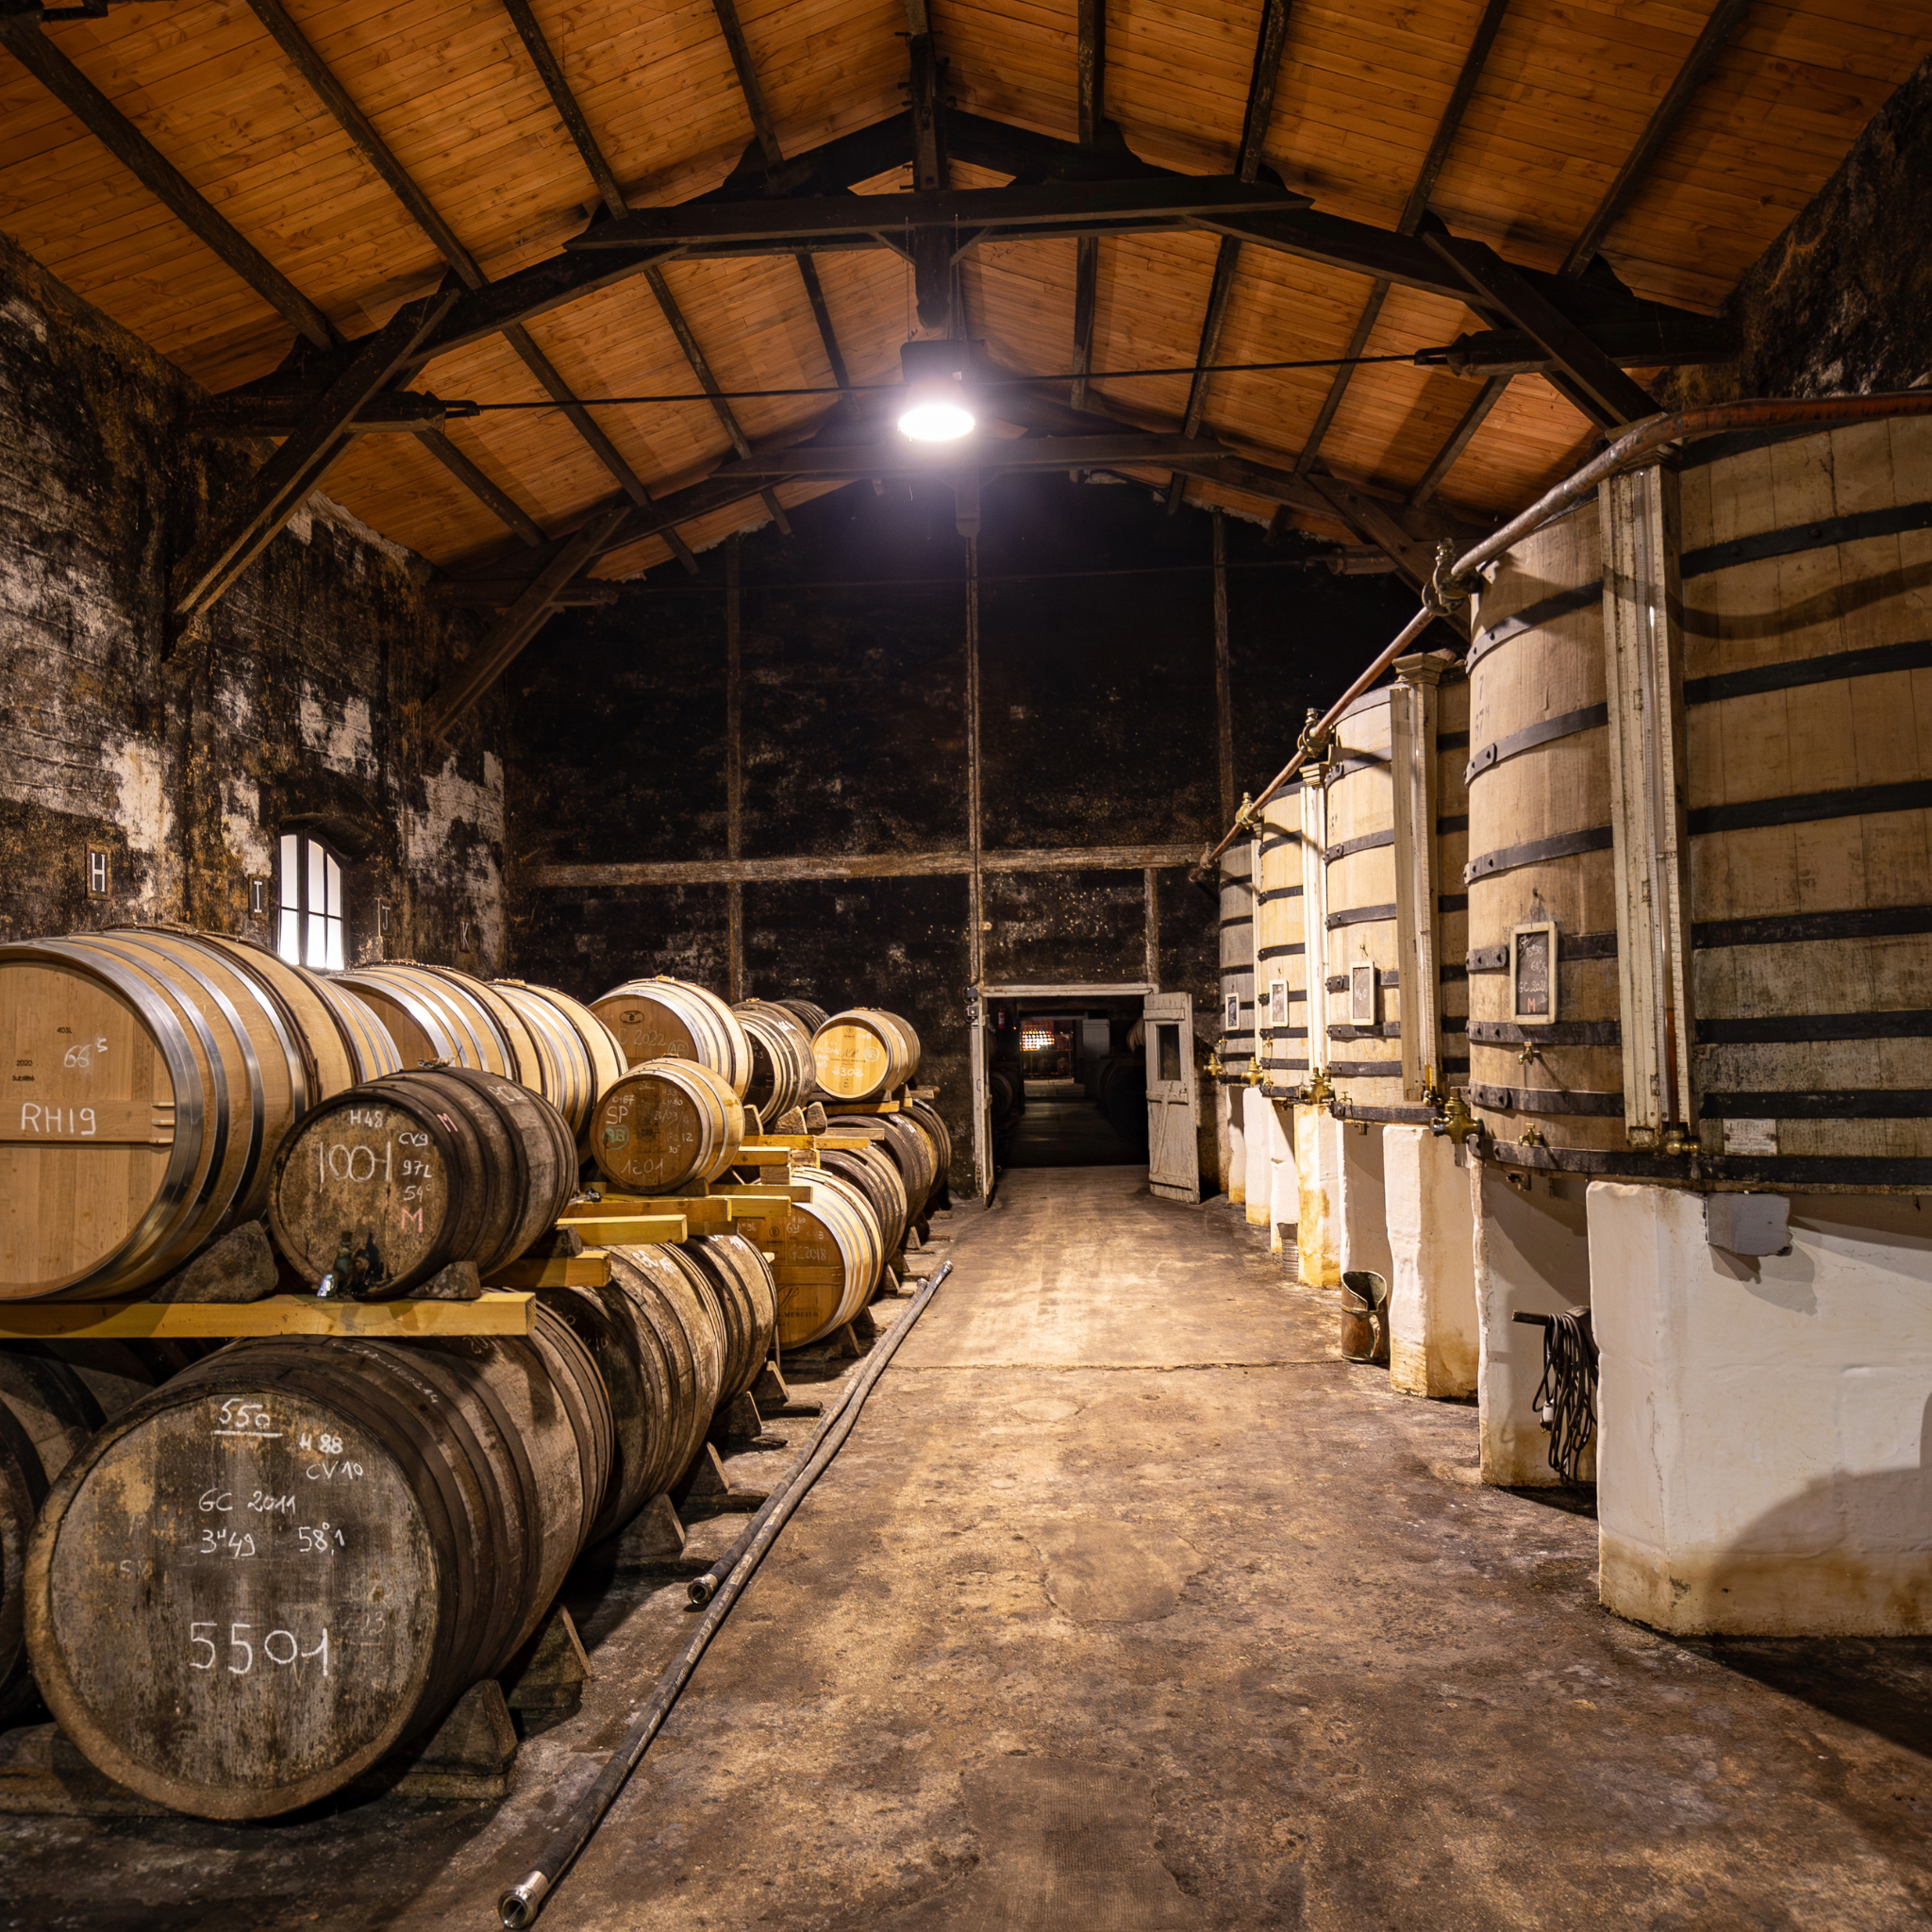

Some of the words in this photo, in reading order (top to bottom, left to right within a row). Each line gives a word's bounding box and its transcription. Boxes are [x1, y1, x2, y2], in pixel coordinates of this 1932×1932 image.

[91, 853, 107, 892] H
[254, 880, 263, 913] I
[382, 906, 391, 931] J
[460, 921, 470, 949] K
[832, 1066, 864, 1077] 2302
[21, 1102, 97, 1136] RH19
[606, 1105, 629, 1124] SP
[400, 1207, 424, 1234] M
[218, 1397, 271, 1429] 550
[319, 1433, 343, 1455] 88
[198, 1488, 233, 1512] GC
[247, 1491, 296, 1515] 2011
[190, 1622, 328, 1677] 5501
